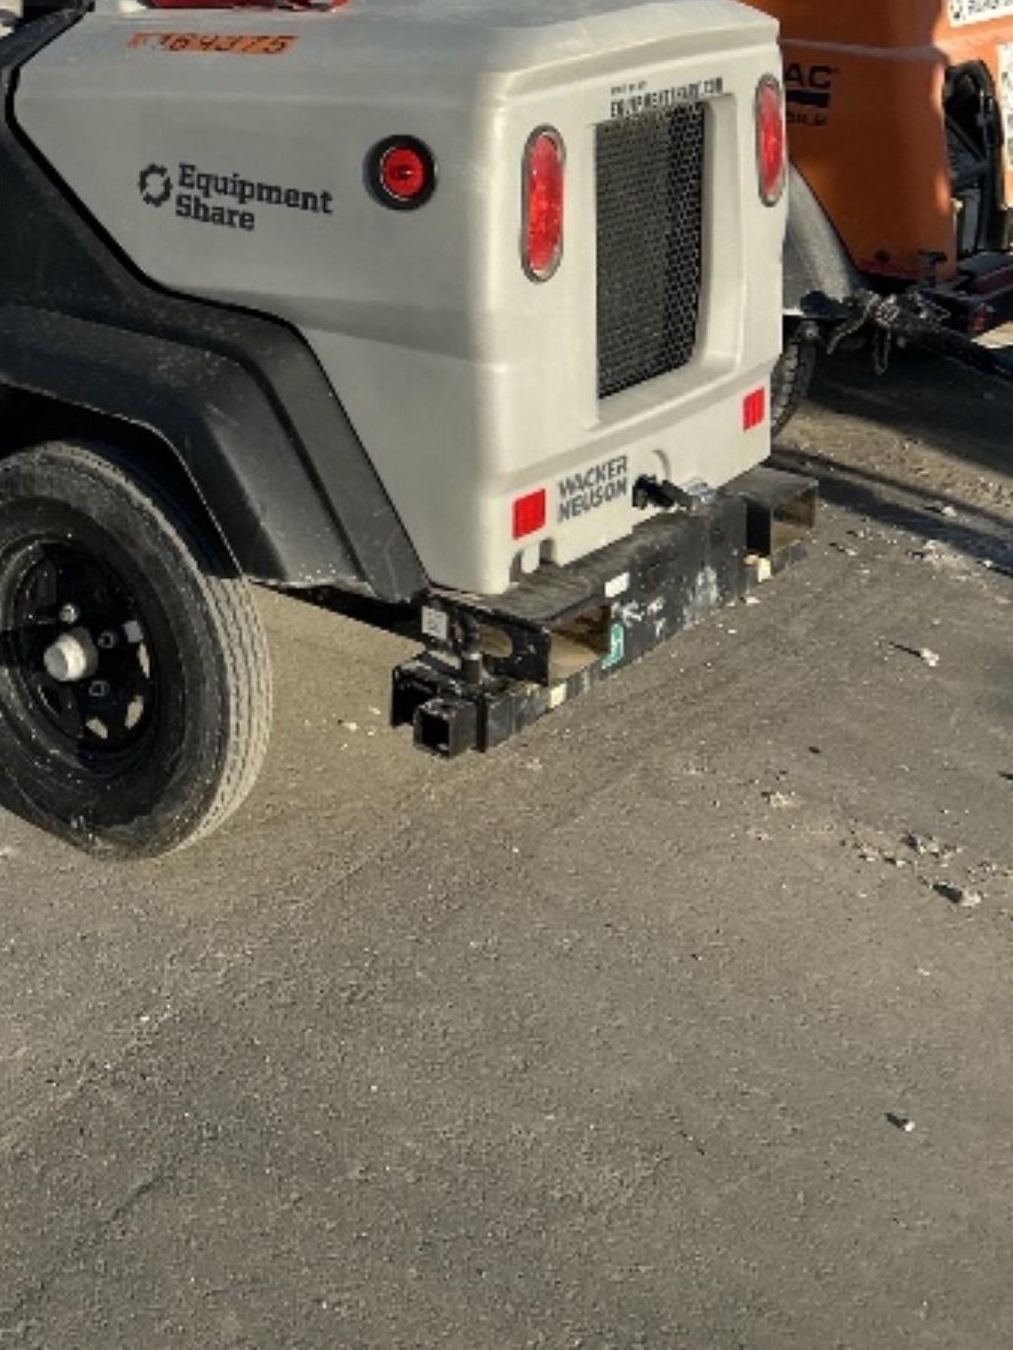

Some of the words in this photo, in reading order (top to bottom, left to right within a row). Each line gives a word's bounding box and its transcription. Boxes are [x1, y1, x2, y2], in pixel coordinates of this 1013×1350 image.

[178, 162, 334, 215] Equipment
[175, 193, 256, 232] Share
[558, 454, 627, 498] WACKER
[557, 476, 627, 525] NEUSON
